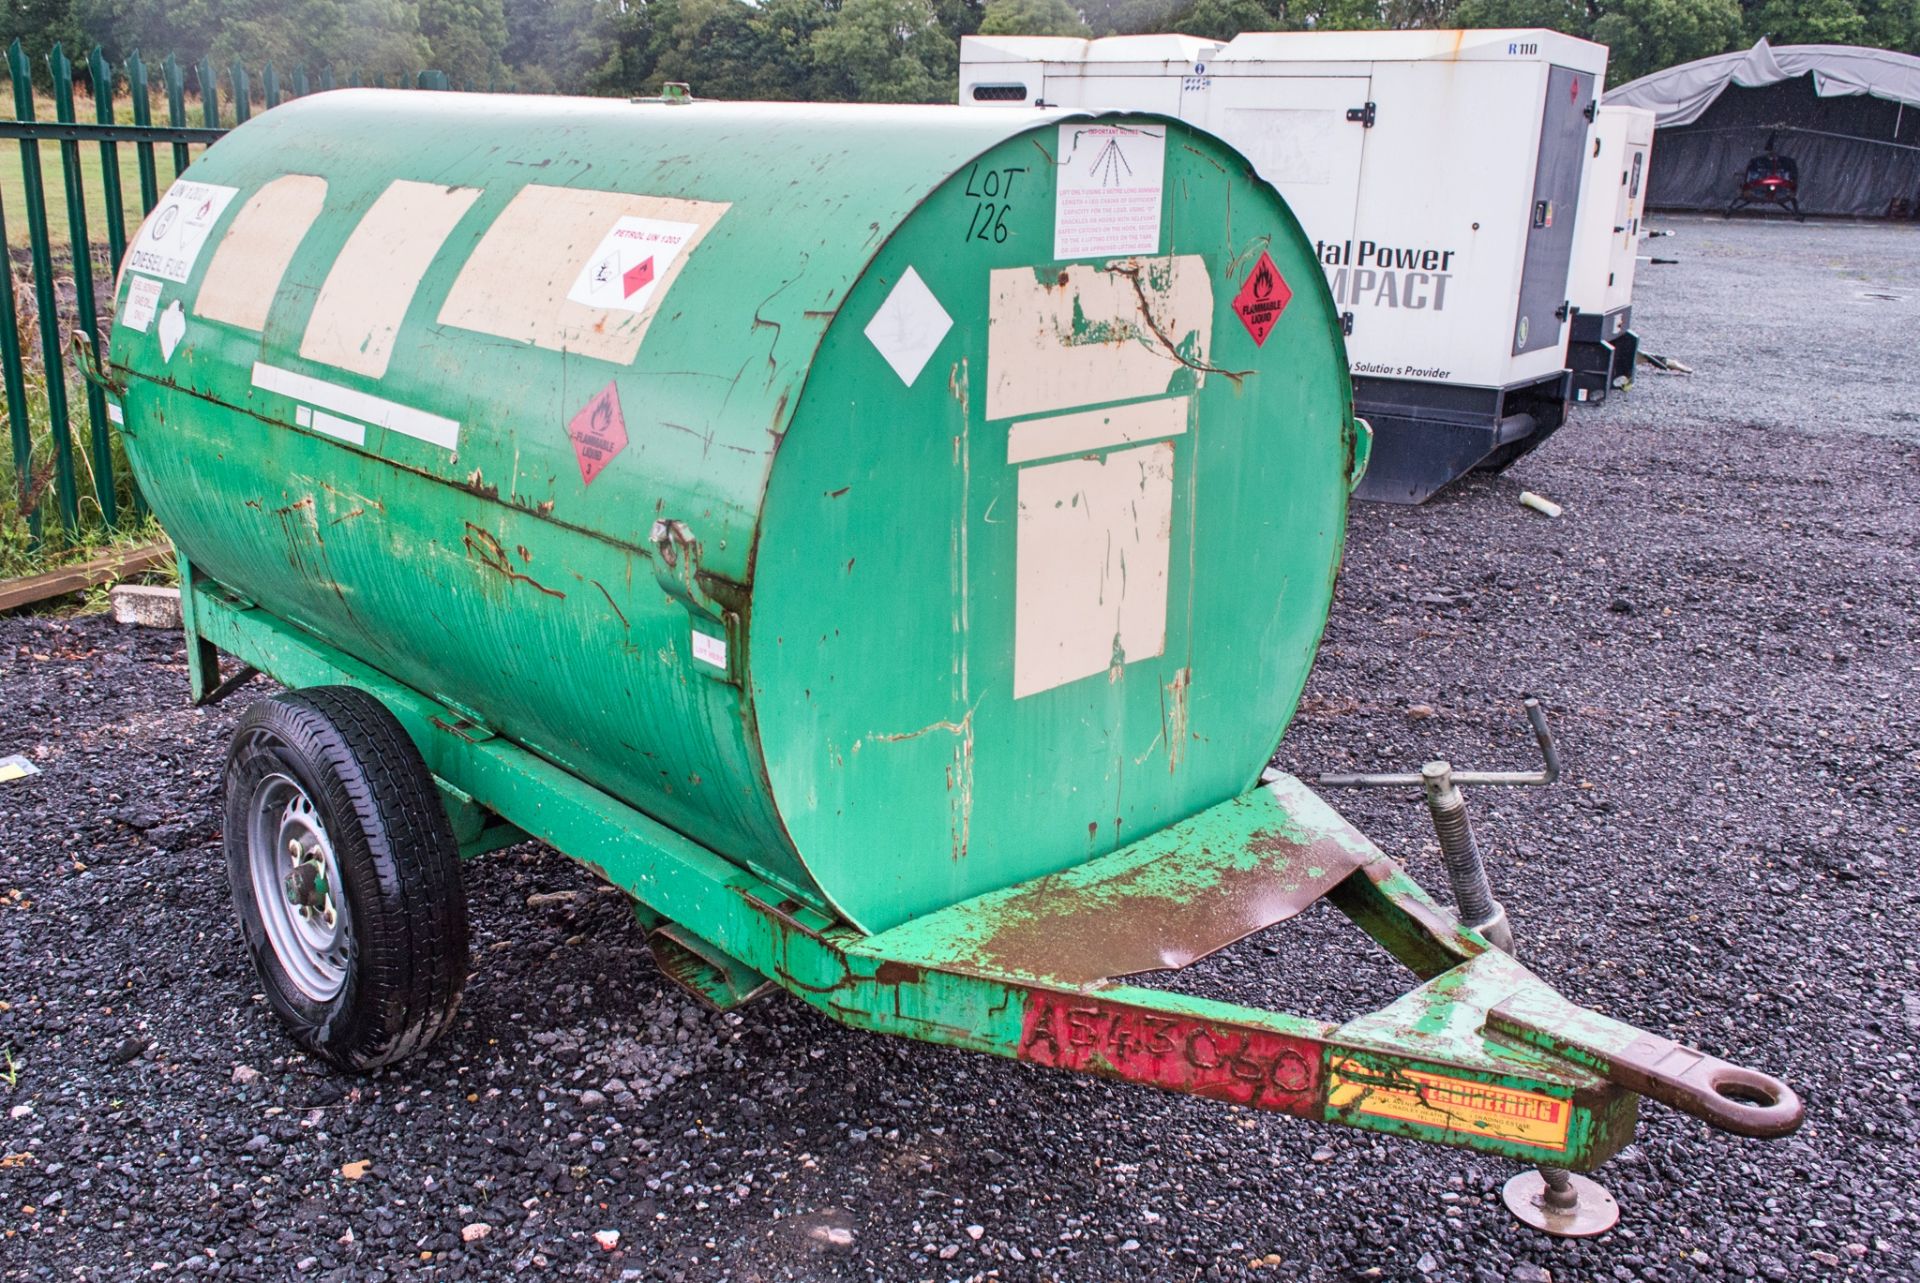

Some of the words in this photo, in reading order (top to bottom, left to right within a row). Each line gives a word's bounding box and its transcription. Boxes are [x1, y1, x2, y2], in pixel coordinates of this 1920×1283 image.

[1508, 43, 1517, 55] R
[1520, 44, 1538, 55] 110
[965, 163, 1026, 200] LOT
[170, 184, 186, 196] UN
[966, 202, 1011, 244] 126
[614, 229, 646, 240] PETROL
[660, 235, 681, 244] 1203
[1316, 240, 1352, 266] tal
[1358, 240, 1455, 272] Power
[131, 250, 163, 272] DIESEL
[163, 258, 187, 278] FUEL
[1323, 267, 1453, 311] MPACT
[1242, 300, 1282, 316] FLAMMABLE
[1251, 312, 1272, 324] LIQUID
[1258, 327, 1263, 337] 3
[1404, 365, 1451, 378] Provider
[573, 431, 615, 453] FLAMMABLE
[582, 446, 602, 460] LIQUID
